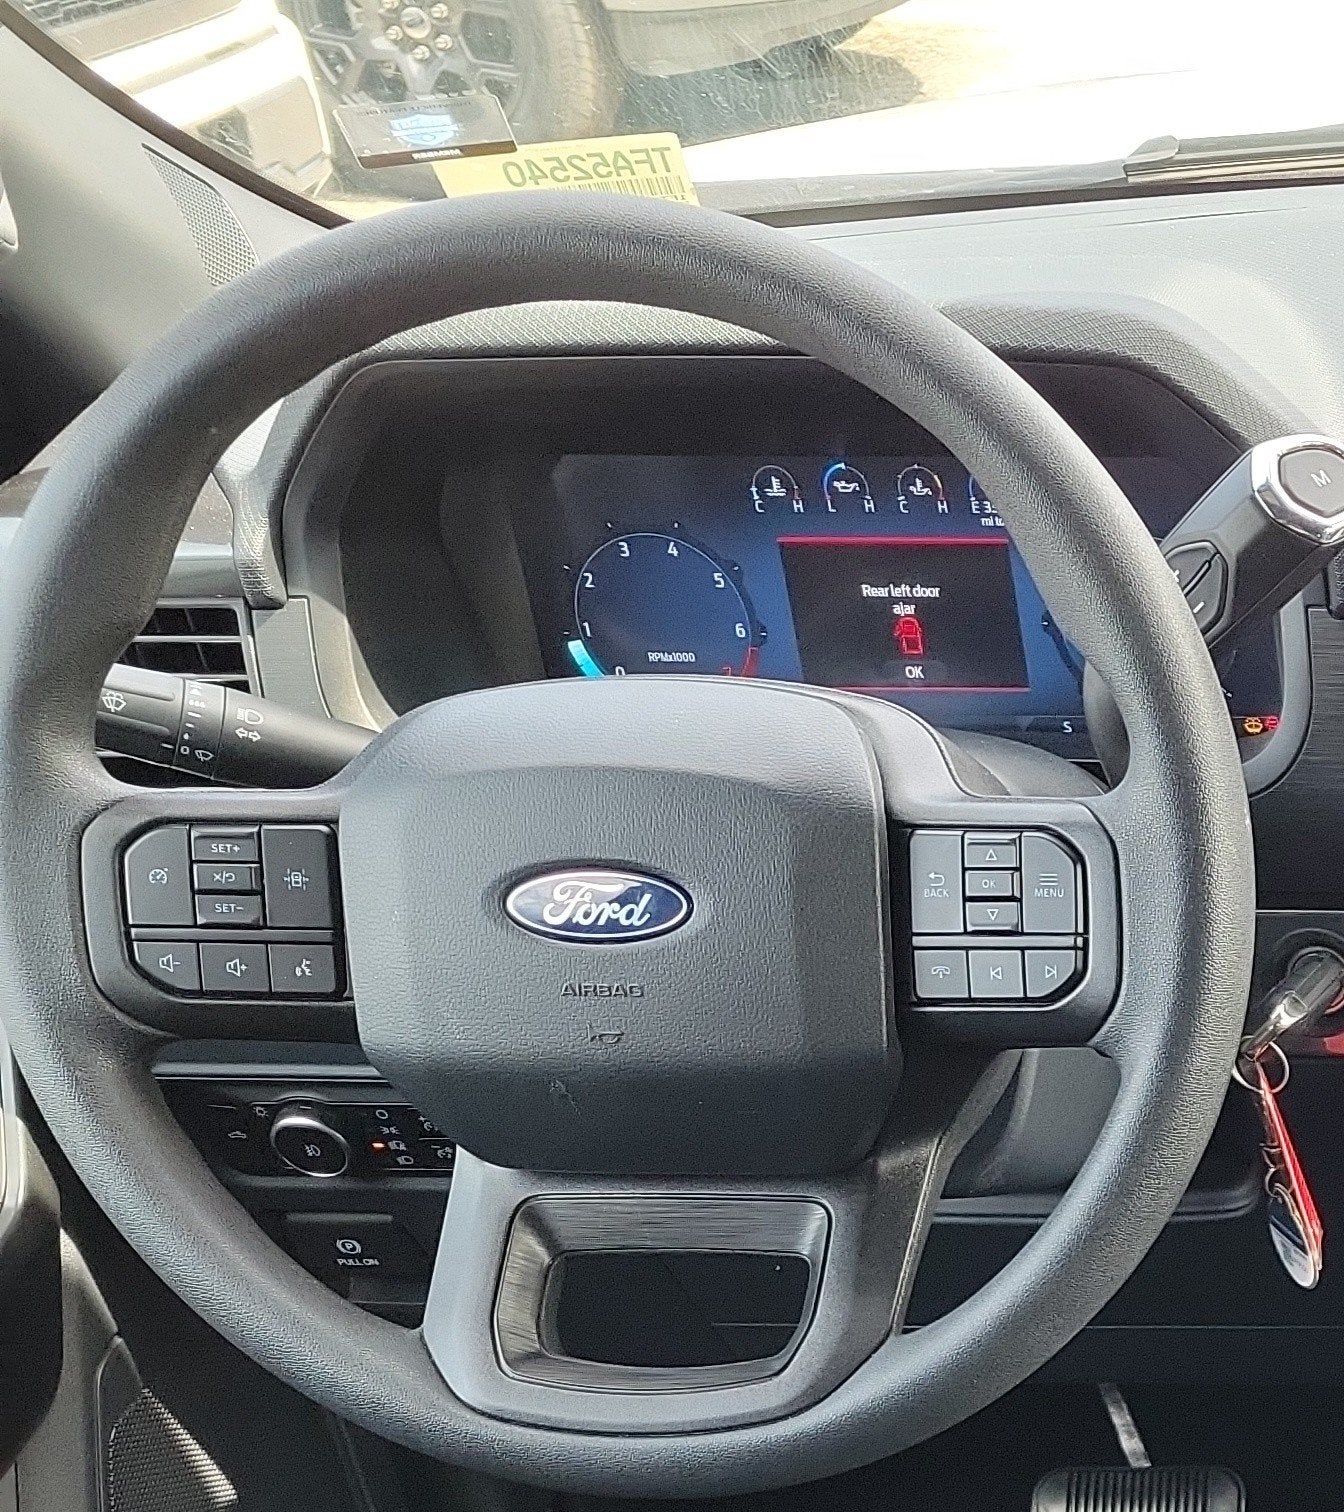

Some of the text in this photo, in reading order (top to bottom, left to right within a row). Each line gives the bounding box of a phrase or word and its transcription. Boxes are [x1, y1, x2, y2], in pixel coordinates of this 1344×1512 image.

[1310, 468, 1332, 489] M
[754, 500, 765, 513] C
[793, 500, 804, 513] H
[827, 500, 837, 513] L
[864, 500, 875, 513] H
[899, 500, 909, 514] C
[937, 500, 948, 513] H
[971, 501, 980, 514] E
[618, 541, 630, 557] 3
[667, 541, 679, 557] 4
[583, 572, 595, 588] 2
[713, 572, 725, 588] 5
[861, 583, 941, 597] Rear left door
[892, 601, 916, 616] ajar
[583, 621, 592, 638] 1
[735, 622, 746, 638] 6
[904, 665, 924, 679] OK
[1062, 721, 1073, 733] S
[982, 879, 996, 889] OK
[924, 888, 950, 898] BACK
[1034, 888, 1064, 898] MENU
[542, 880, 652, 926] Ford
[560, 983, 645, 998] AIRBAG
[336, 1258, 380, 1266] PULL ON
